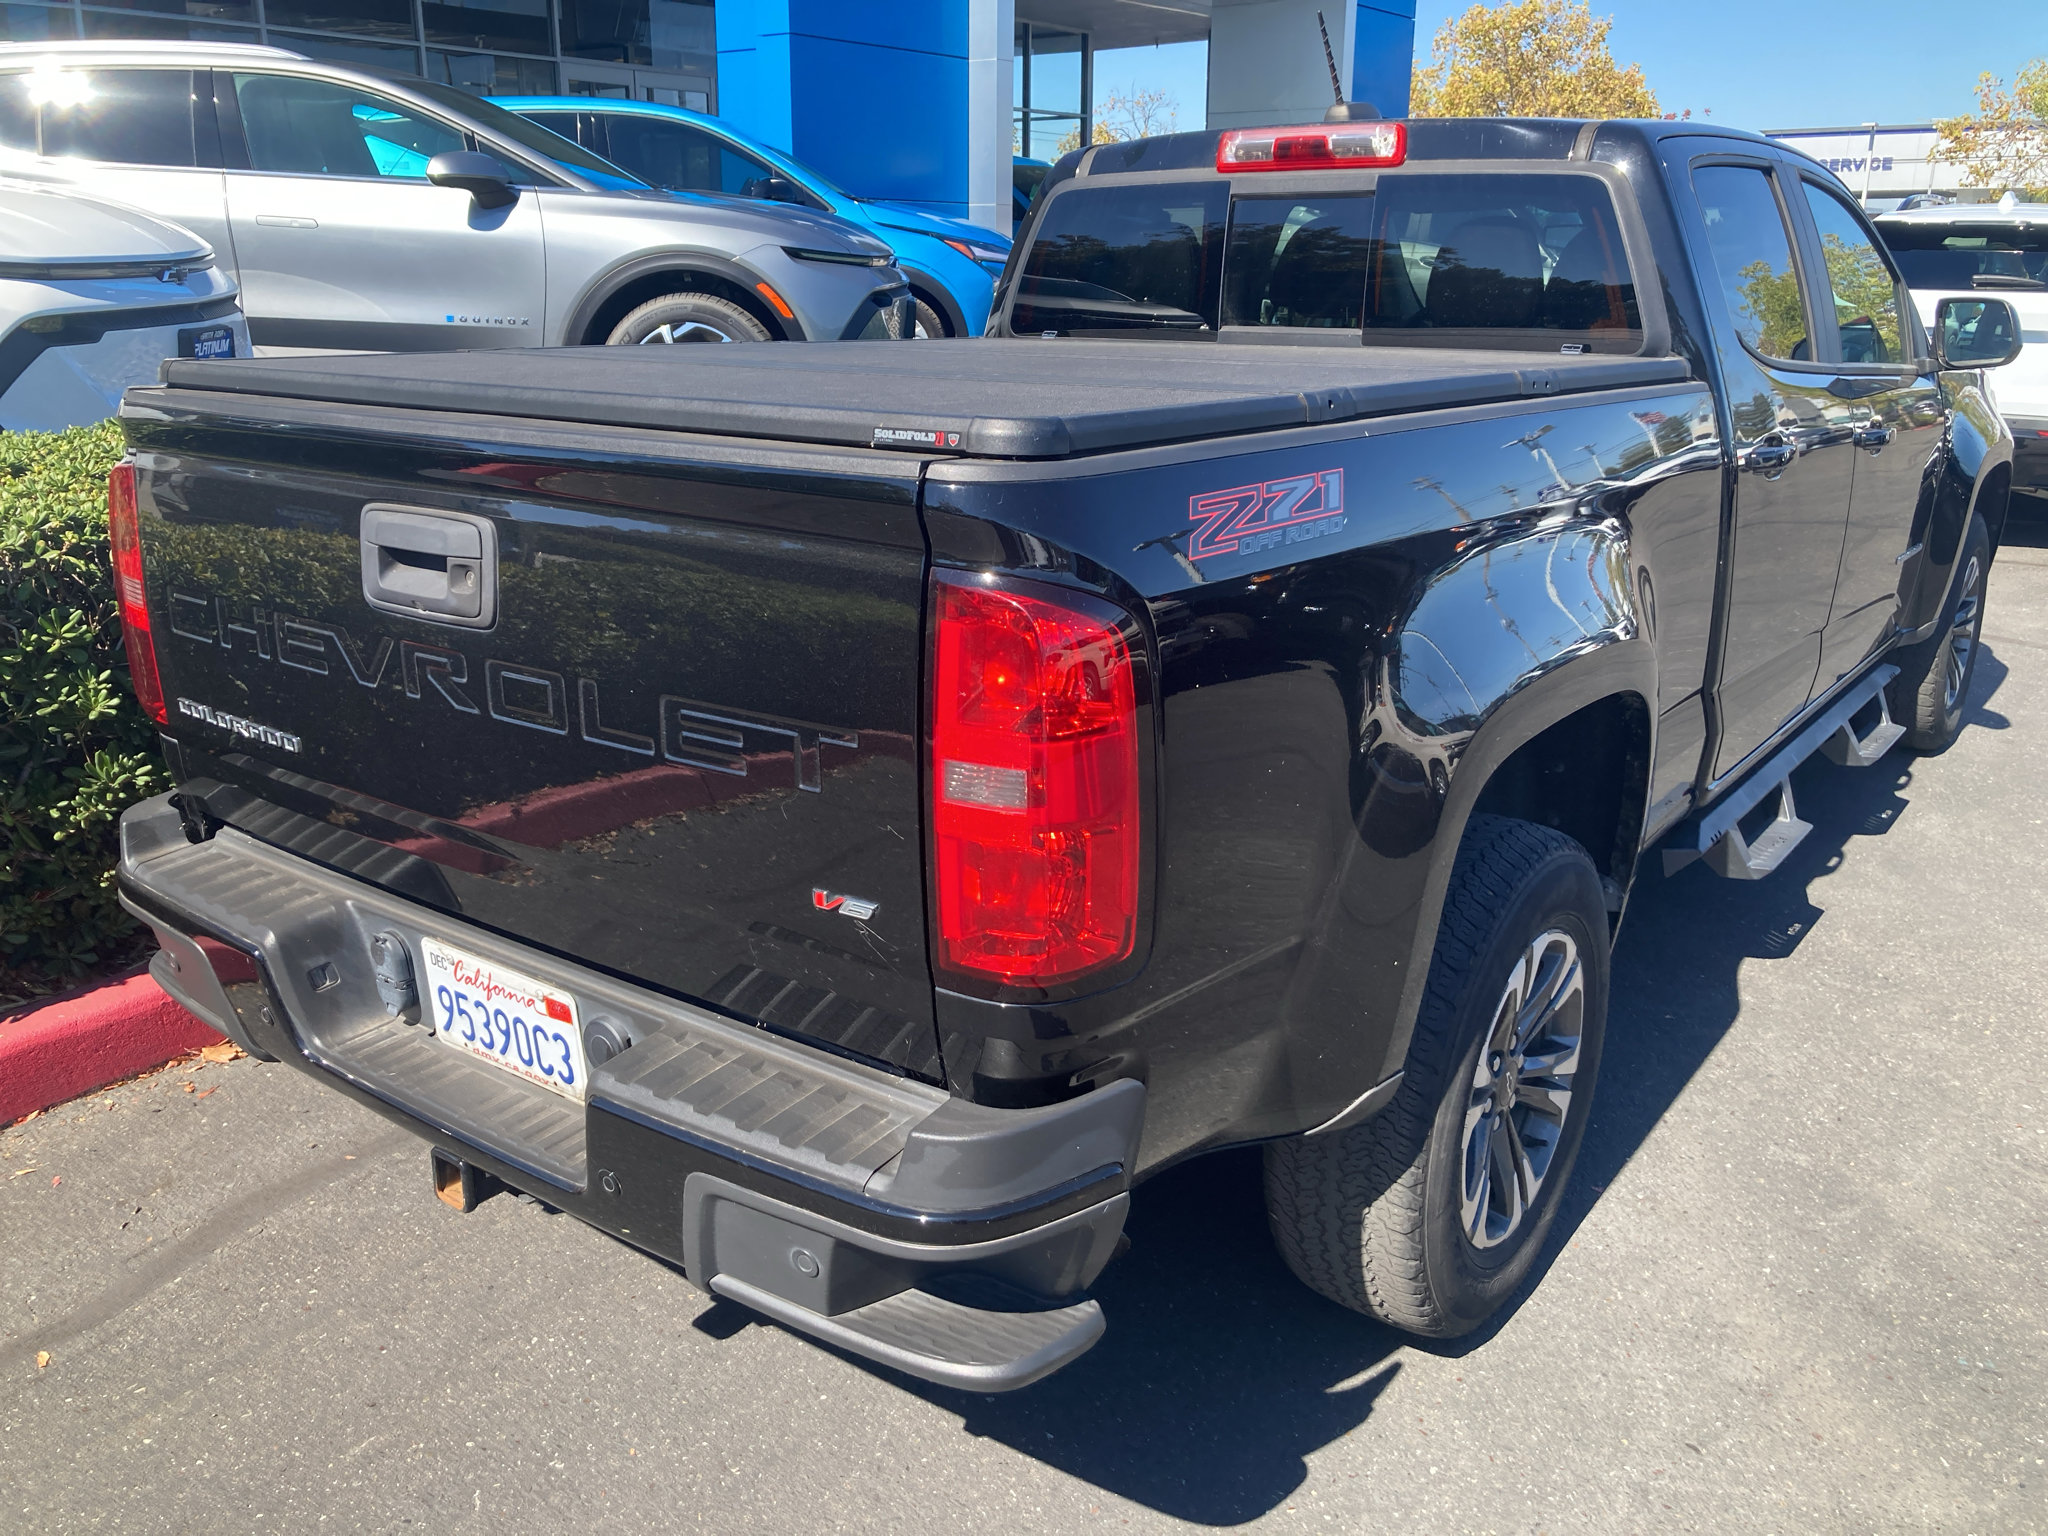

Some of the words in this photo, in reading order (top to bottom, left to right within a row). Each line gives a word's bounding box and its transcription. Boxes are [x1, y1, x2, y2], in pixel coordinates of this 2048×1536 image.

[194, 339, 230, 356] PLATINUM
[874, 428, 936, 442] SOLIDFOLD
[1188, 467, 1345, 561] Z71
[1239, 527, 1283, 556] OFF
[1285, 515, 1344, 545] ROAD
[167, 583, 859, 794] CHEVROLET
[176, 697, 303, 753] COLORADO
[812, 887, 881, 920] V6
[430, 951, 448, 971] DEC
[453, 959, 548, 1017] California
[437, 984, 575, 1085] 95390C3
